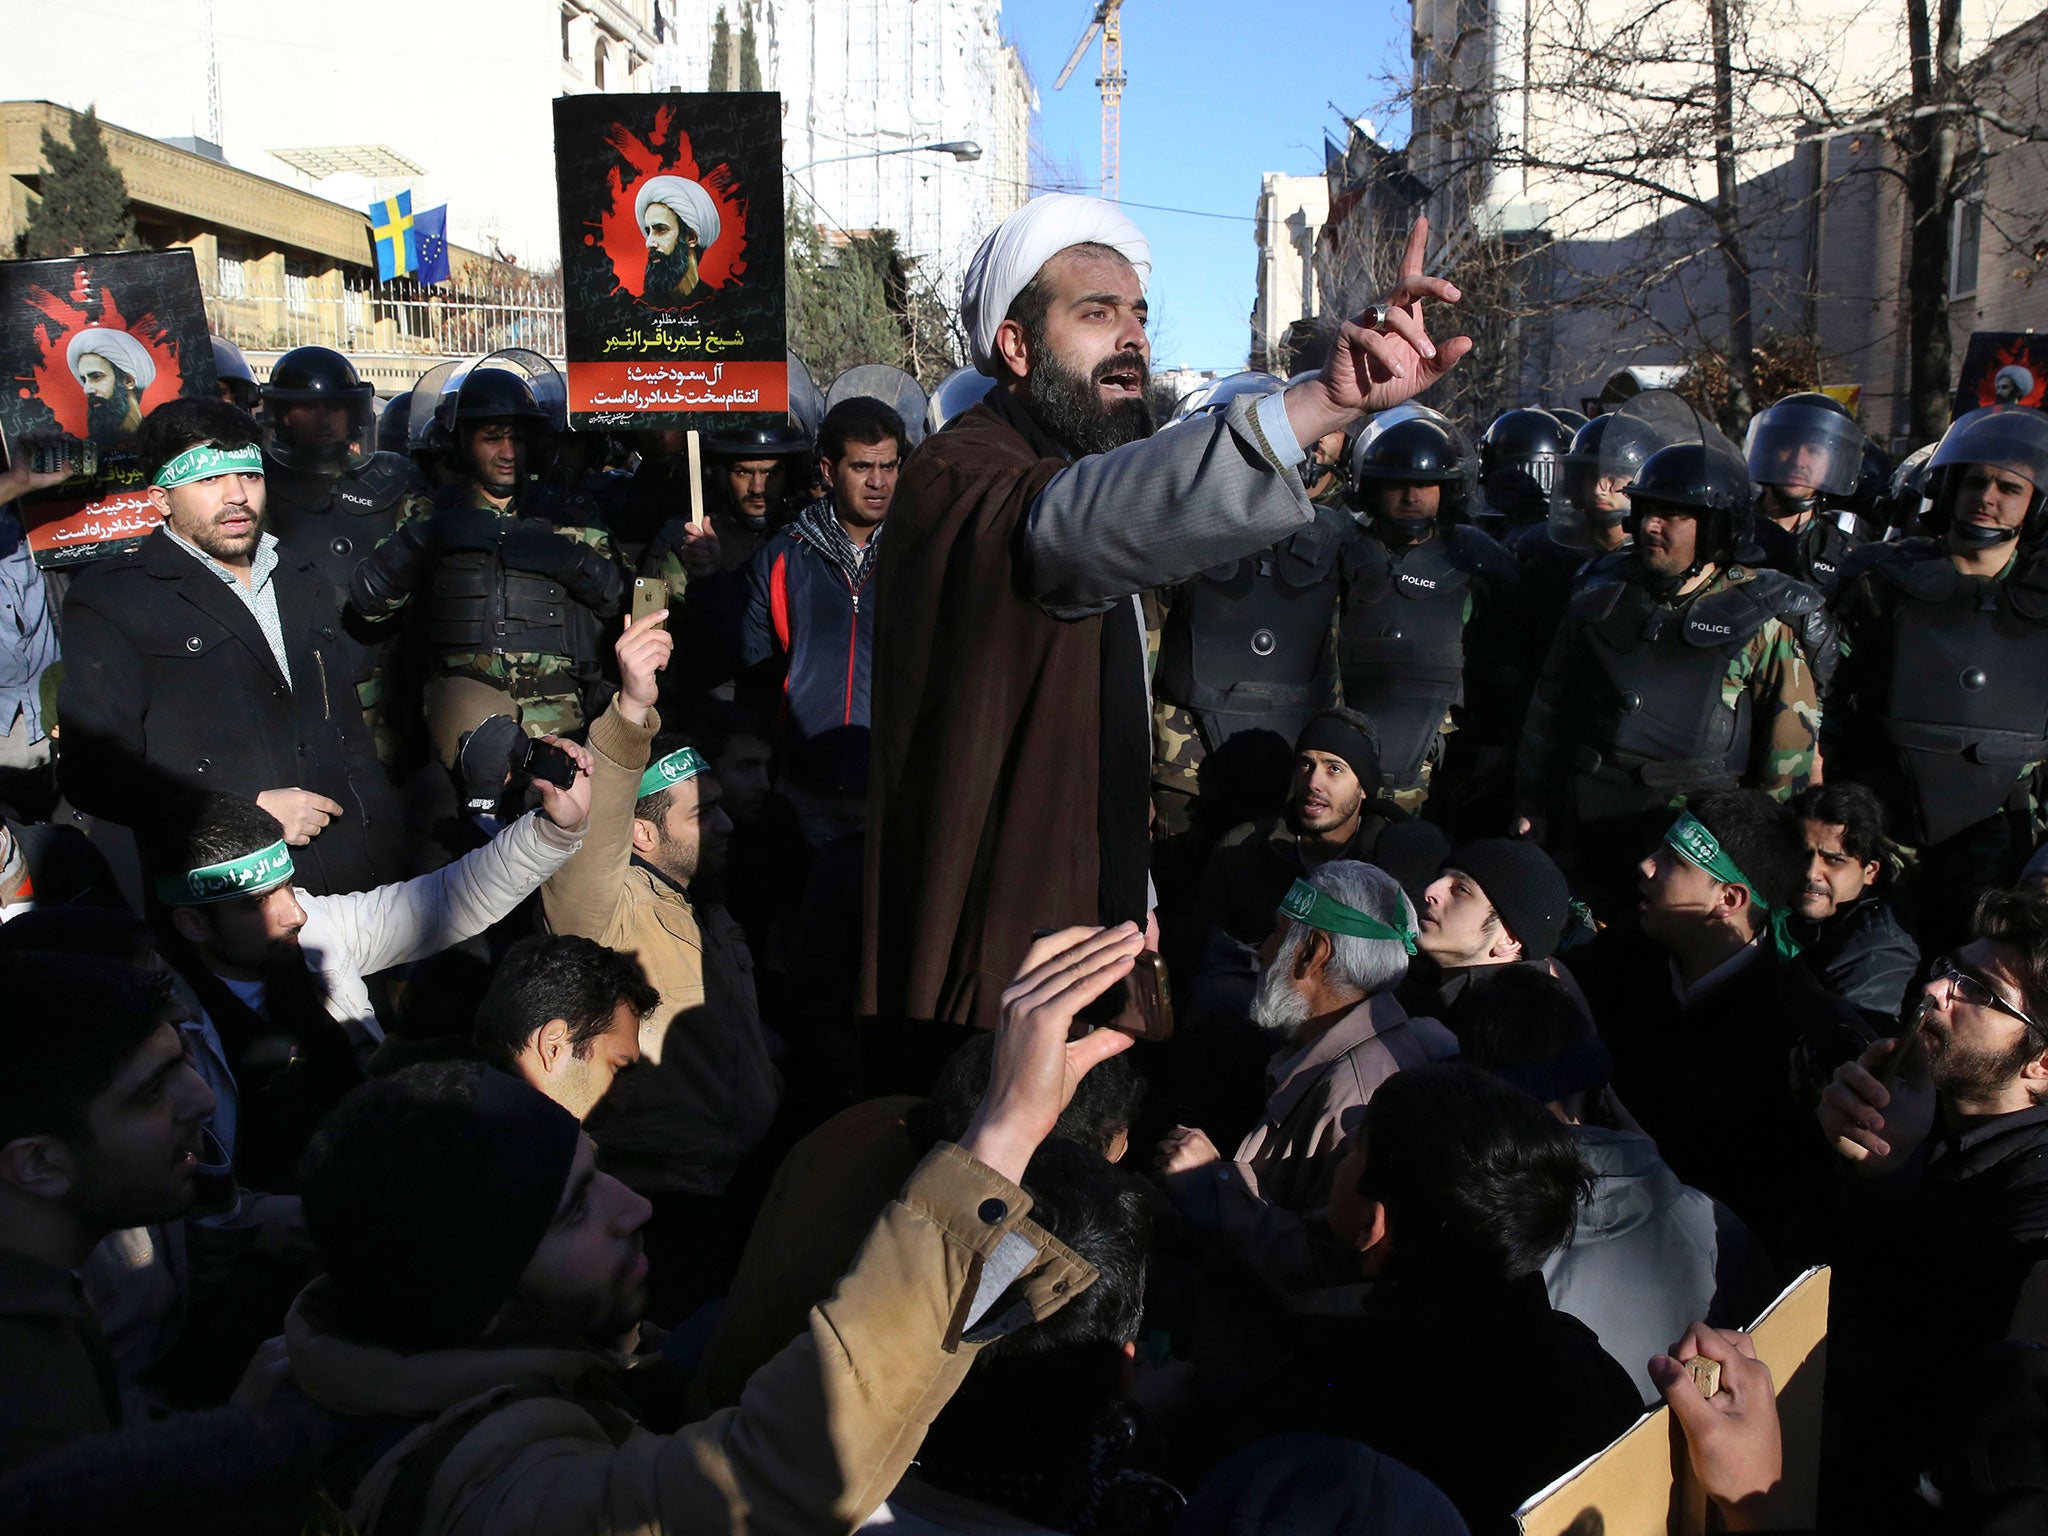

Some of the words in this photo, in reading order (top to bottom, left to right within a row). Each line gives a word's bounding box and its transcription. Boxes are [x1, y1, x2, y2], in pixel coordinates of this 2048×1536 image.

[651, 313, 676, 328] مظلوم
[678, 313, 699, 327] شهید
[639, 328, 672, 353] باقر
[705, 329, 744, 353] شیخ
[668, 367, 706, 386] سعود
[705, 362, 724, 386] آل
[589, 388, 628, 405] است.
[628, 388, 643, 409] راه
[641, 391, 656, 409] در
[655, 388, 685, 404] خدا
[684, 388, 726, 404] سخت
[725, 388, 759, 412] انتقام
[342, 493, 373, 507] POLICE
[1401, 574, 1436, 589] POLICE
[1690, 621, 1731, 635] POLICE
